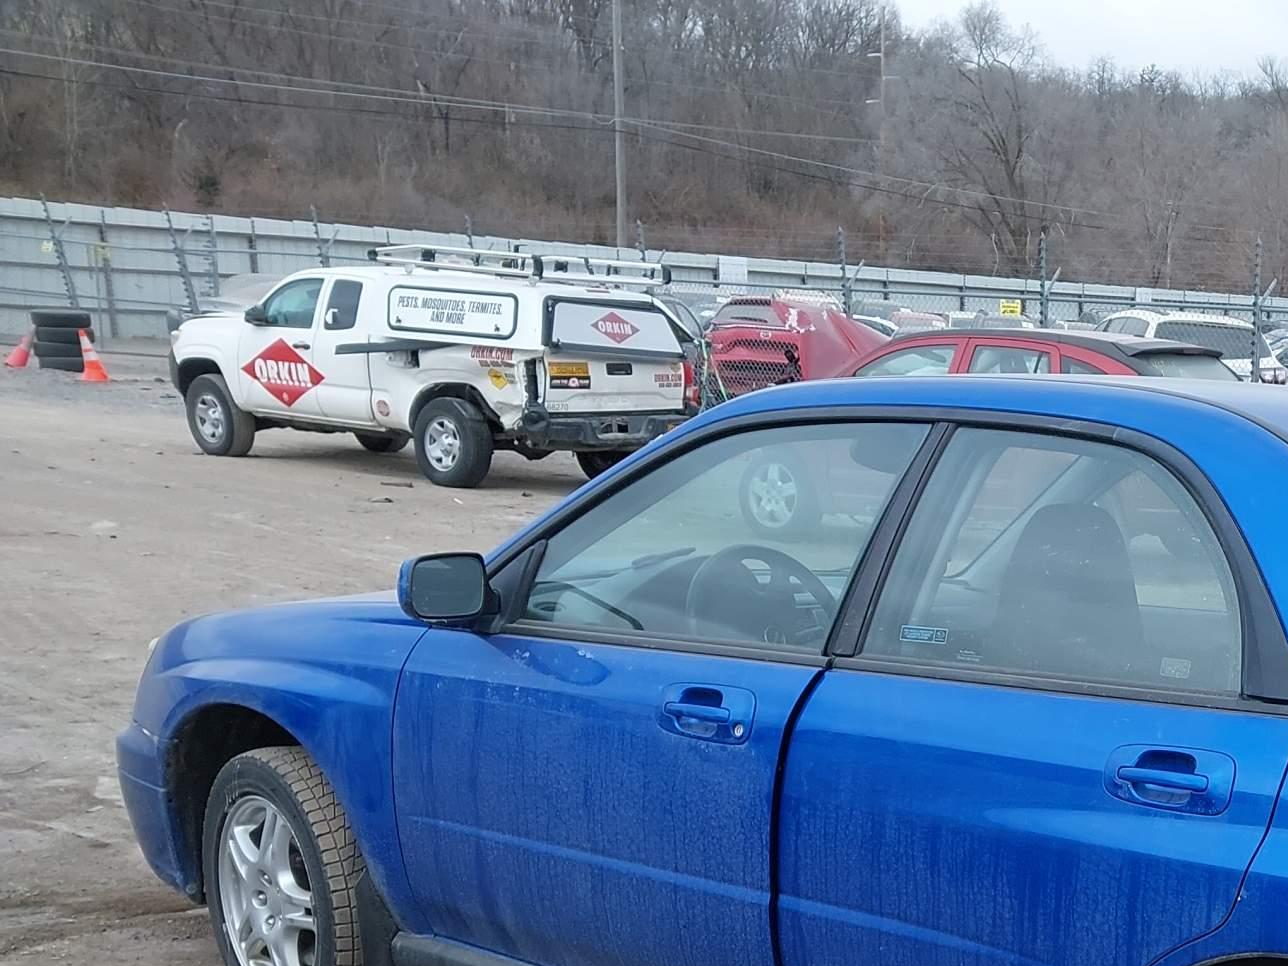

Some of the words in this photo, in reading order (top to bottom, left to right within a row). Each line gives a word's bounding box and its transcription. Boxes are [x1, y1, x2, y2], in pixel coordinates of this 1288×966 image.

[430, 311, 445, 323] AND
[445, 312, 466, 325] MORE
[598, 321, 632, 335] ORKIN
[254, 358, 312, 387] ORKIN
